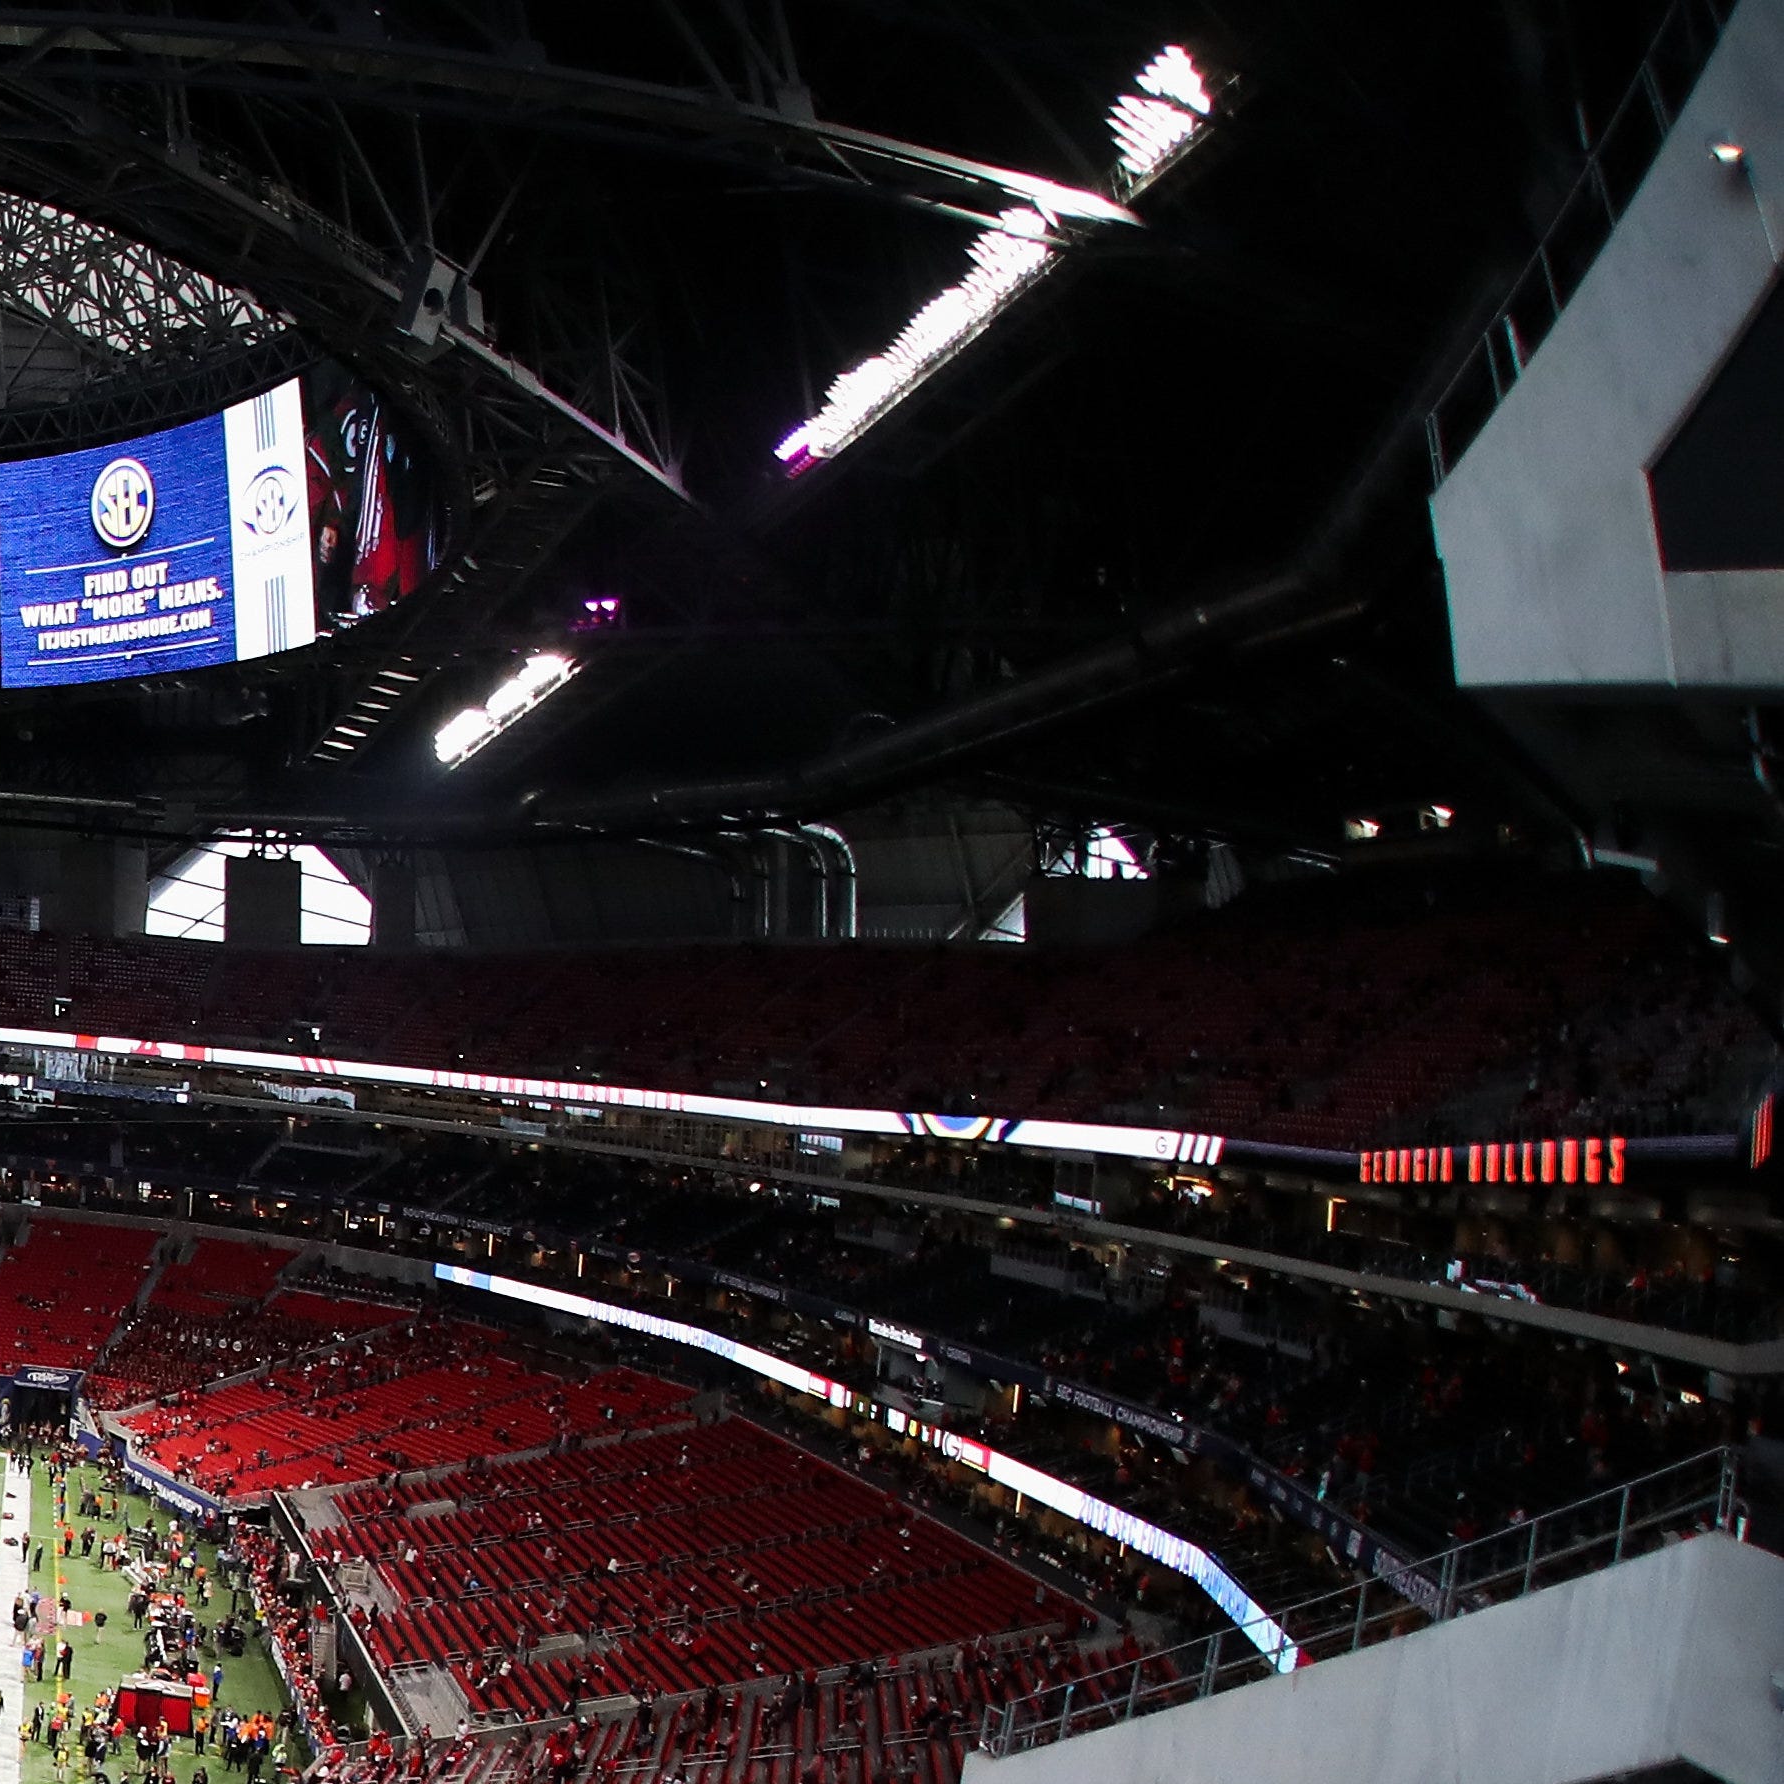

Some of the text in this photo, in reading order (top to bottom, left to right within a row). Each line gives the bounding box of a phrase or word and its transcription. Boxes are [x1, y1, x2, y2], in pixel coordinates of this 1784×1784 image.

[98, 468, 147, 538] SEC
[256, 478, 285, 533] SEC
[239, 532, 306, 561] CHAMPIONSHIP
[20, 601, 78, 628] WHAT
[158, 577, 223, 611] MEANS.
[84, 562, 169, 598] FIND OUT
[37, 608, 213, 651] ITJUSTMEANSMORE.COM
[1055, 1382, 1185, 1446] SEC FOOTBALL CHAMPIONSHIP
